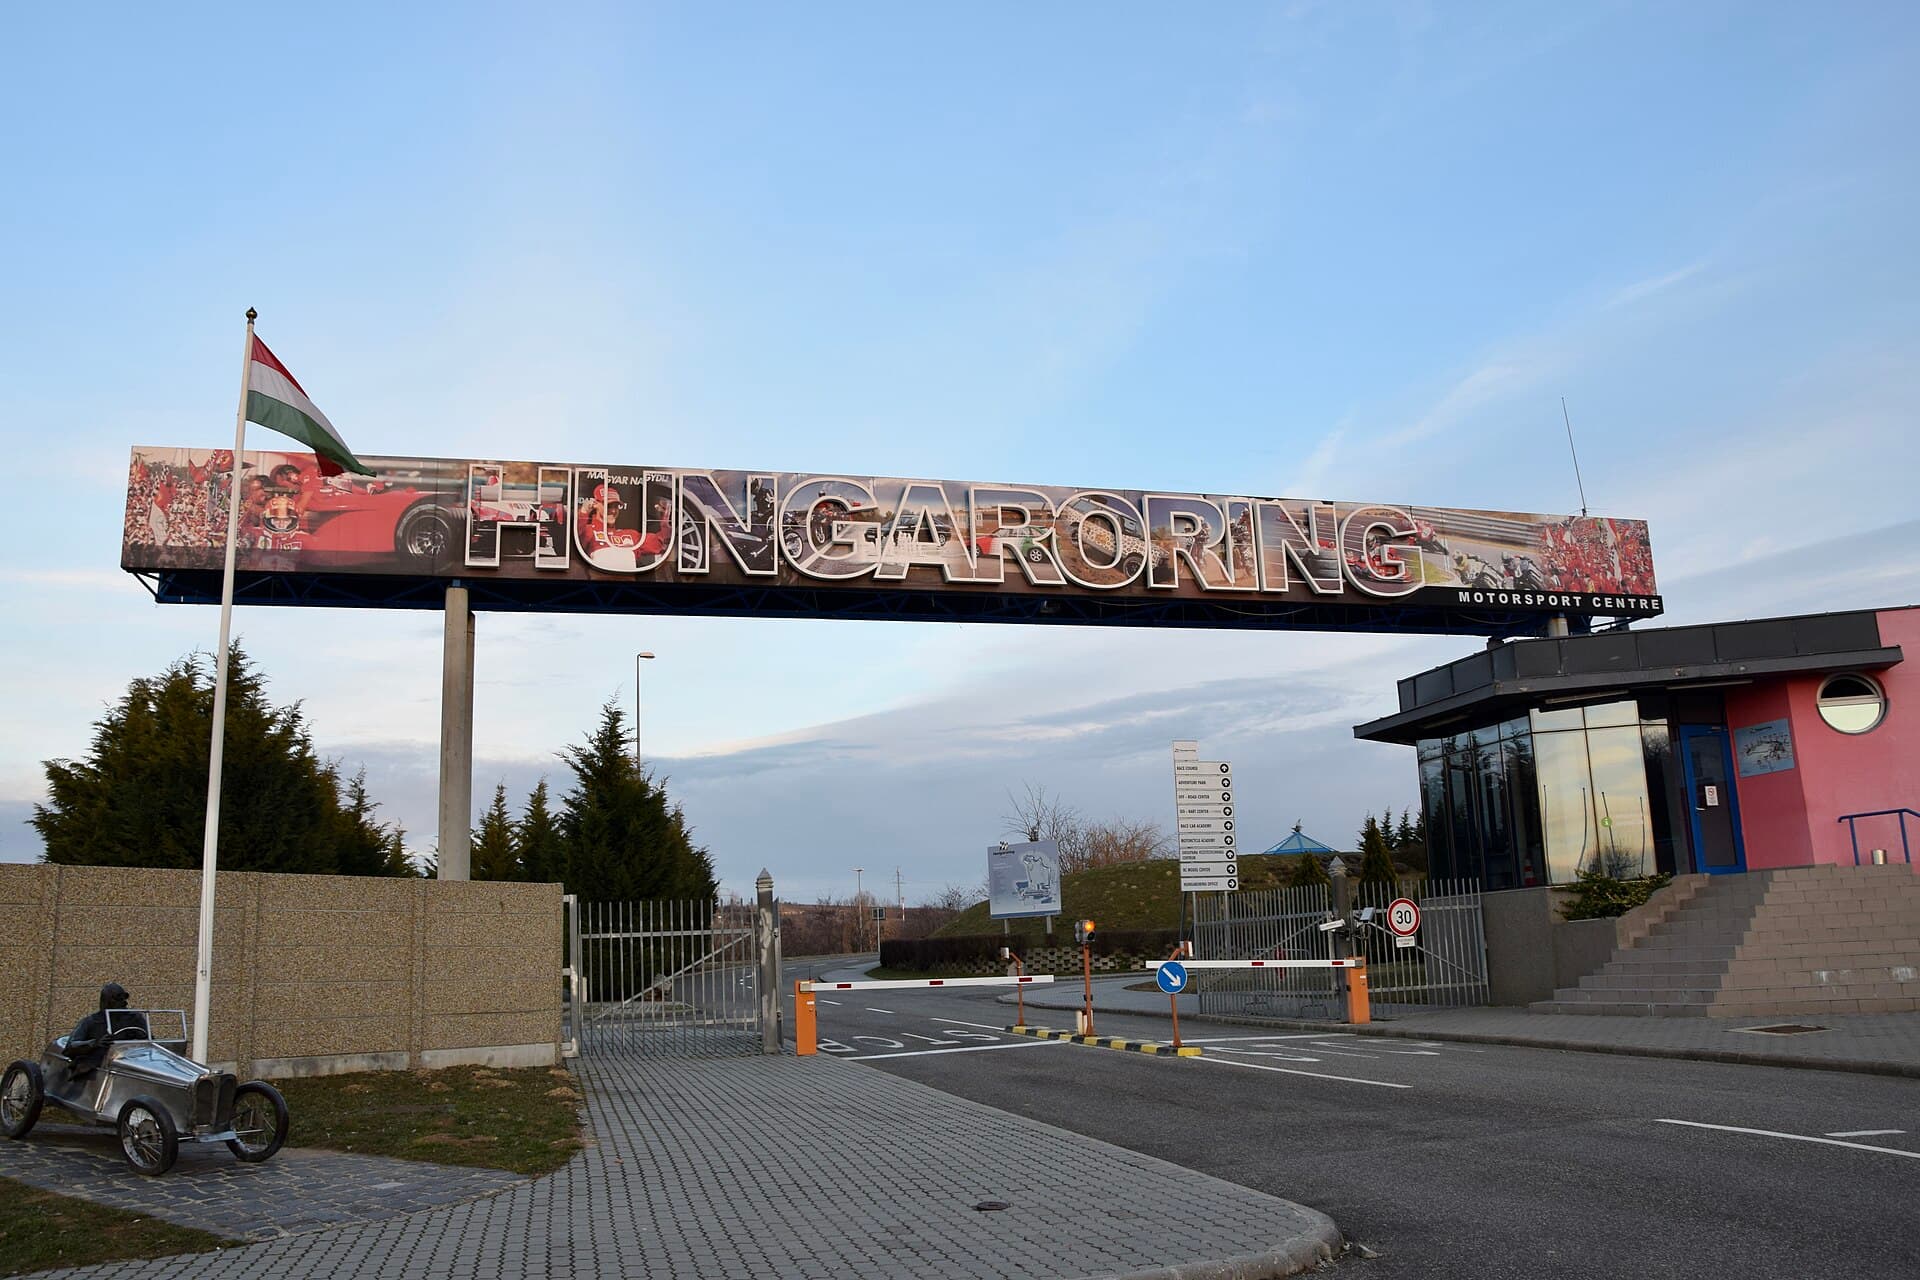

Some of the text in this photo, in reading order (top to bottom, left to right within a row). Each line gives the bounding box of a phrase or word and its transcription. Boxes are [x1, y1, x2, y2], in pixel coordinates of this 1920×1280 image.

[587, 471, 628, 485] MAGYAR
[465, 464, 1425, 597] HUNGARORING
[1458, 591, 1660, 610] MOTORSPORT CENTRE
[1396, 910, 1412, 924] 30
